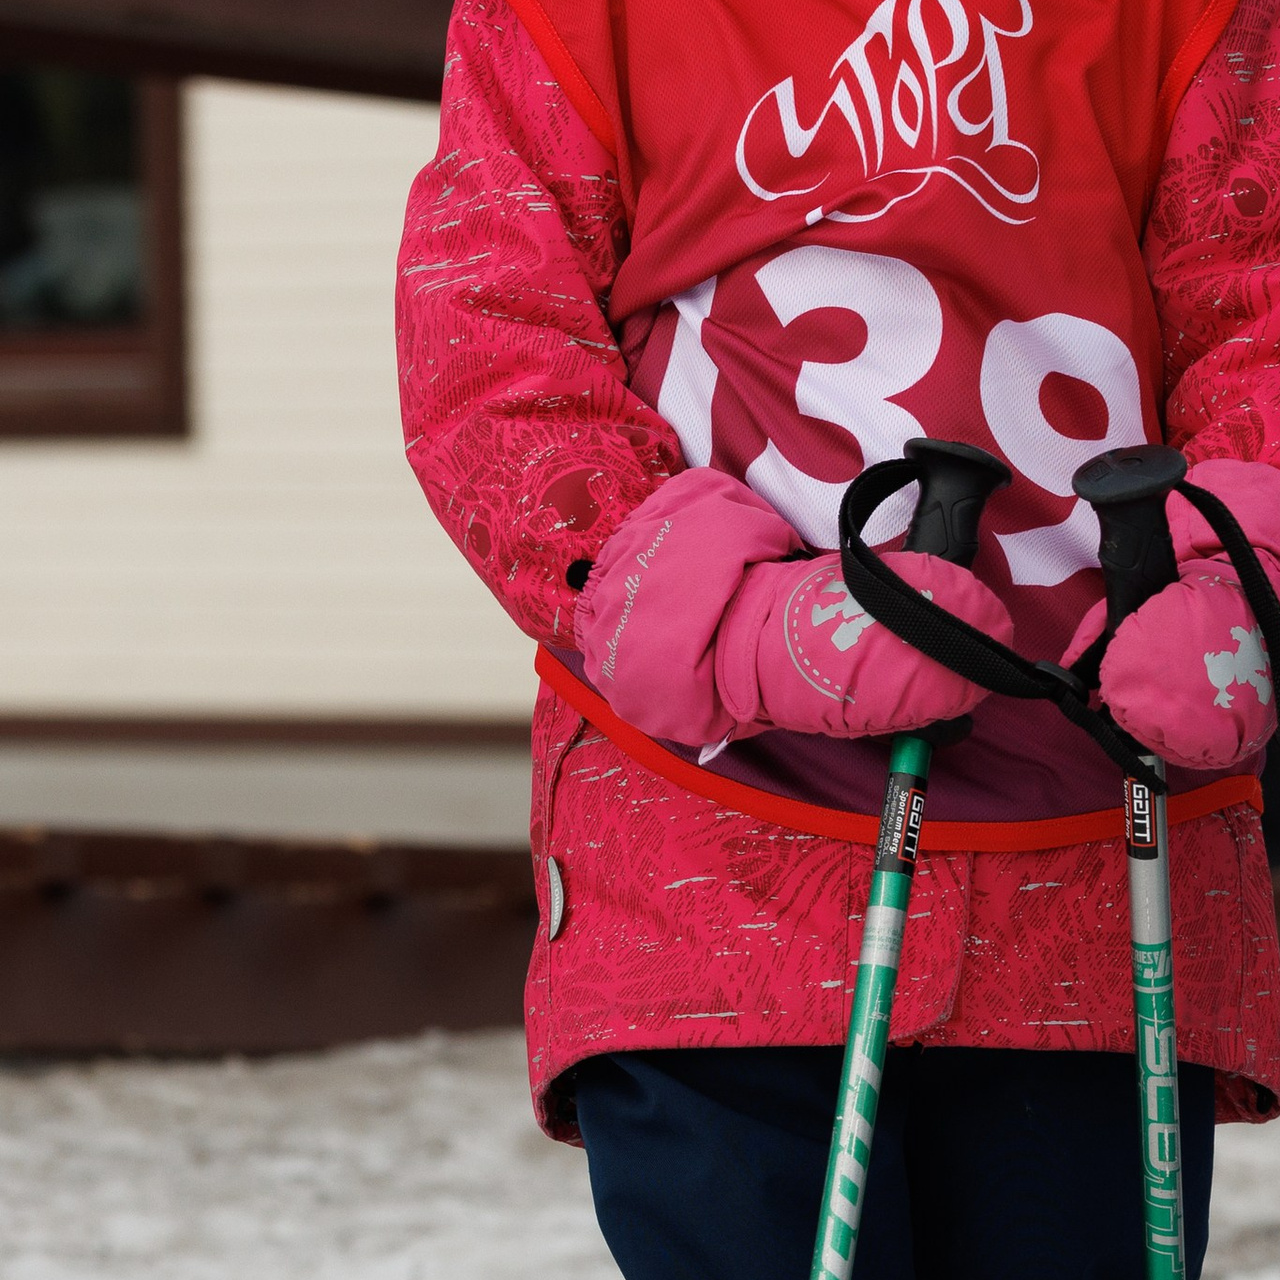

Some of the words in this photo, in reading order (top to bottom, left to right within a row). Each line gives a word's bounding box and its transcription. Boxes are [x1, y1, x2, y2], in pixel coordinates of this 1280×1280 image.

[602, 573, 642, 682] Mademoiselle
[636, 519, 673, 569] Poivre
[898, 790, 909, 815] Sport
[895, 817, 904, 831] am
[889, 831, 902, 855] Berg.
[1143, 1022, 1186, 1272] SCOTT
